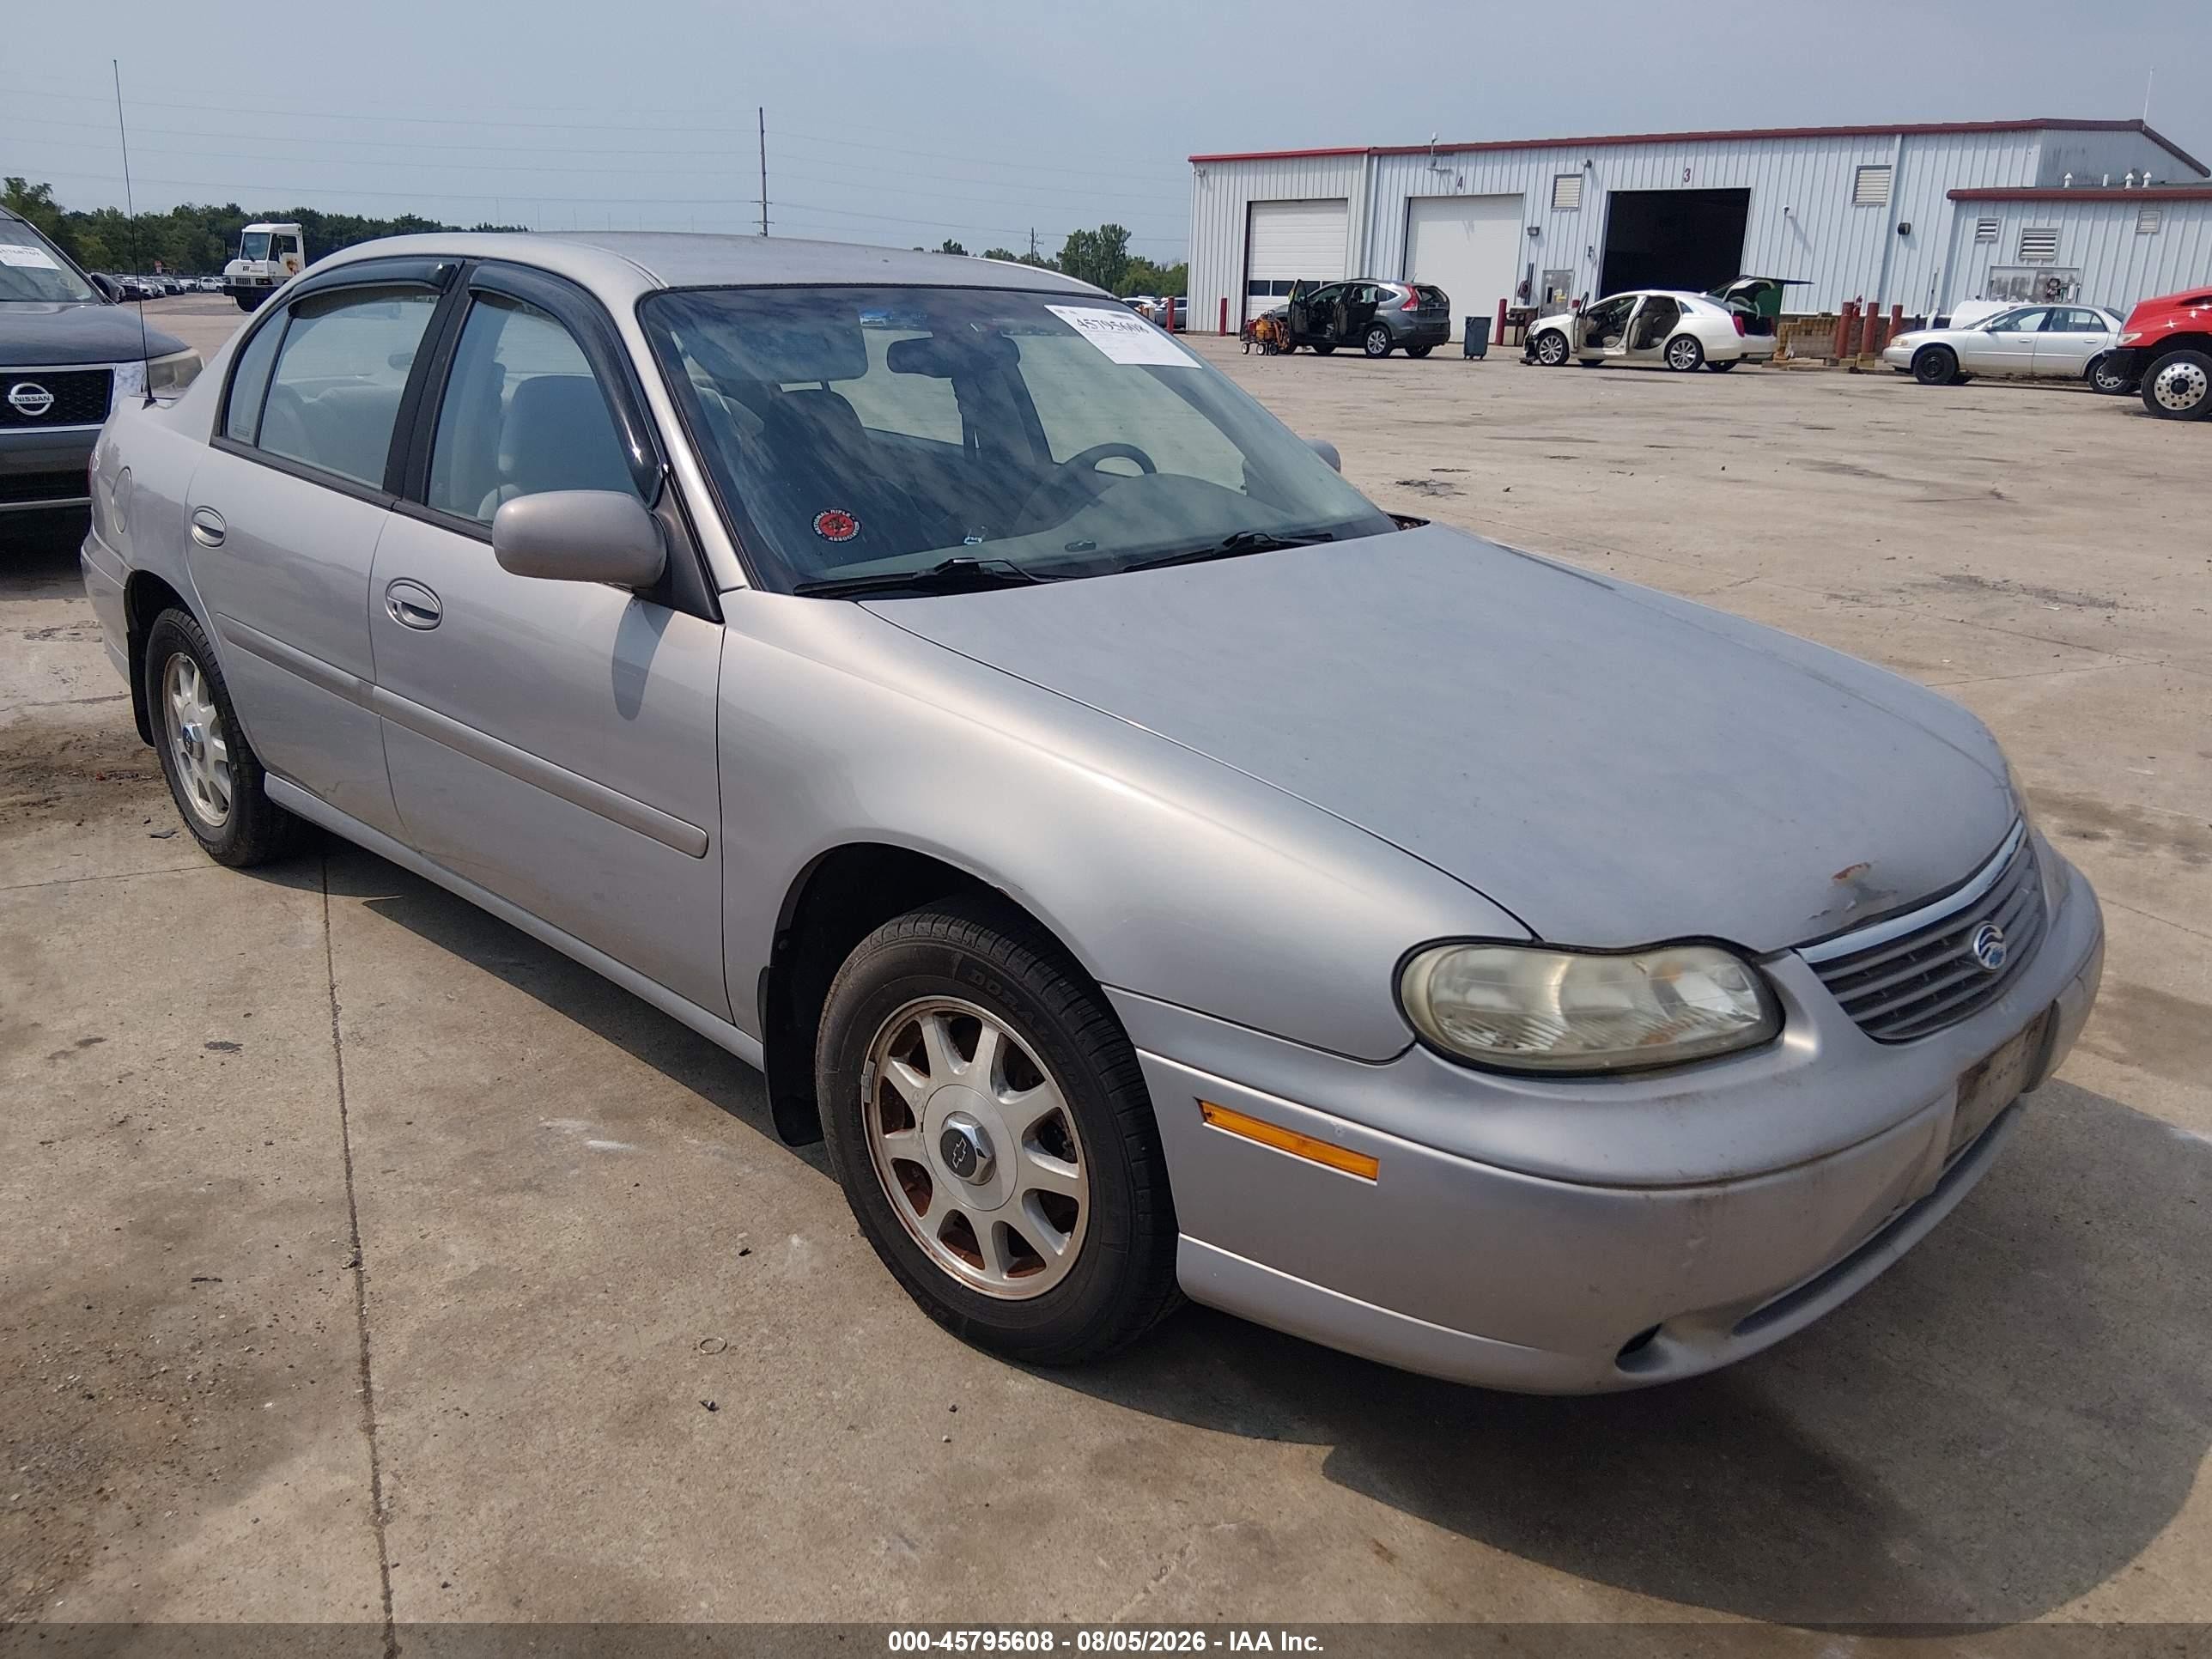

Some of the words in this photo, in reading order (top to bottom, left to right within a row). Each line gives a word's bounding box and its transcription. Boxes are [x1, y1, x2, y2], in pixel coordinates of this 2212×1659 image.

[1457, 175, 1464, 190] 4
[1683, 167, 1692, 183] 3
[1075, 318, 1151, 335] 45795608
[813, 510, 831, 535] NATIONAL
[830, 508, 852, 519] RIFLE
[828, 521, 860, 542] ASSOCIATION
